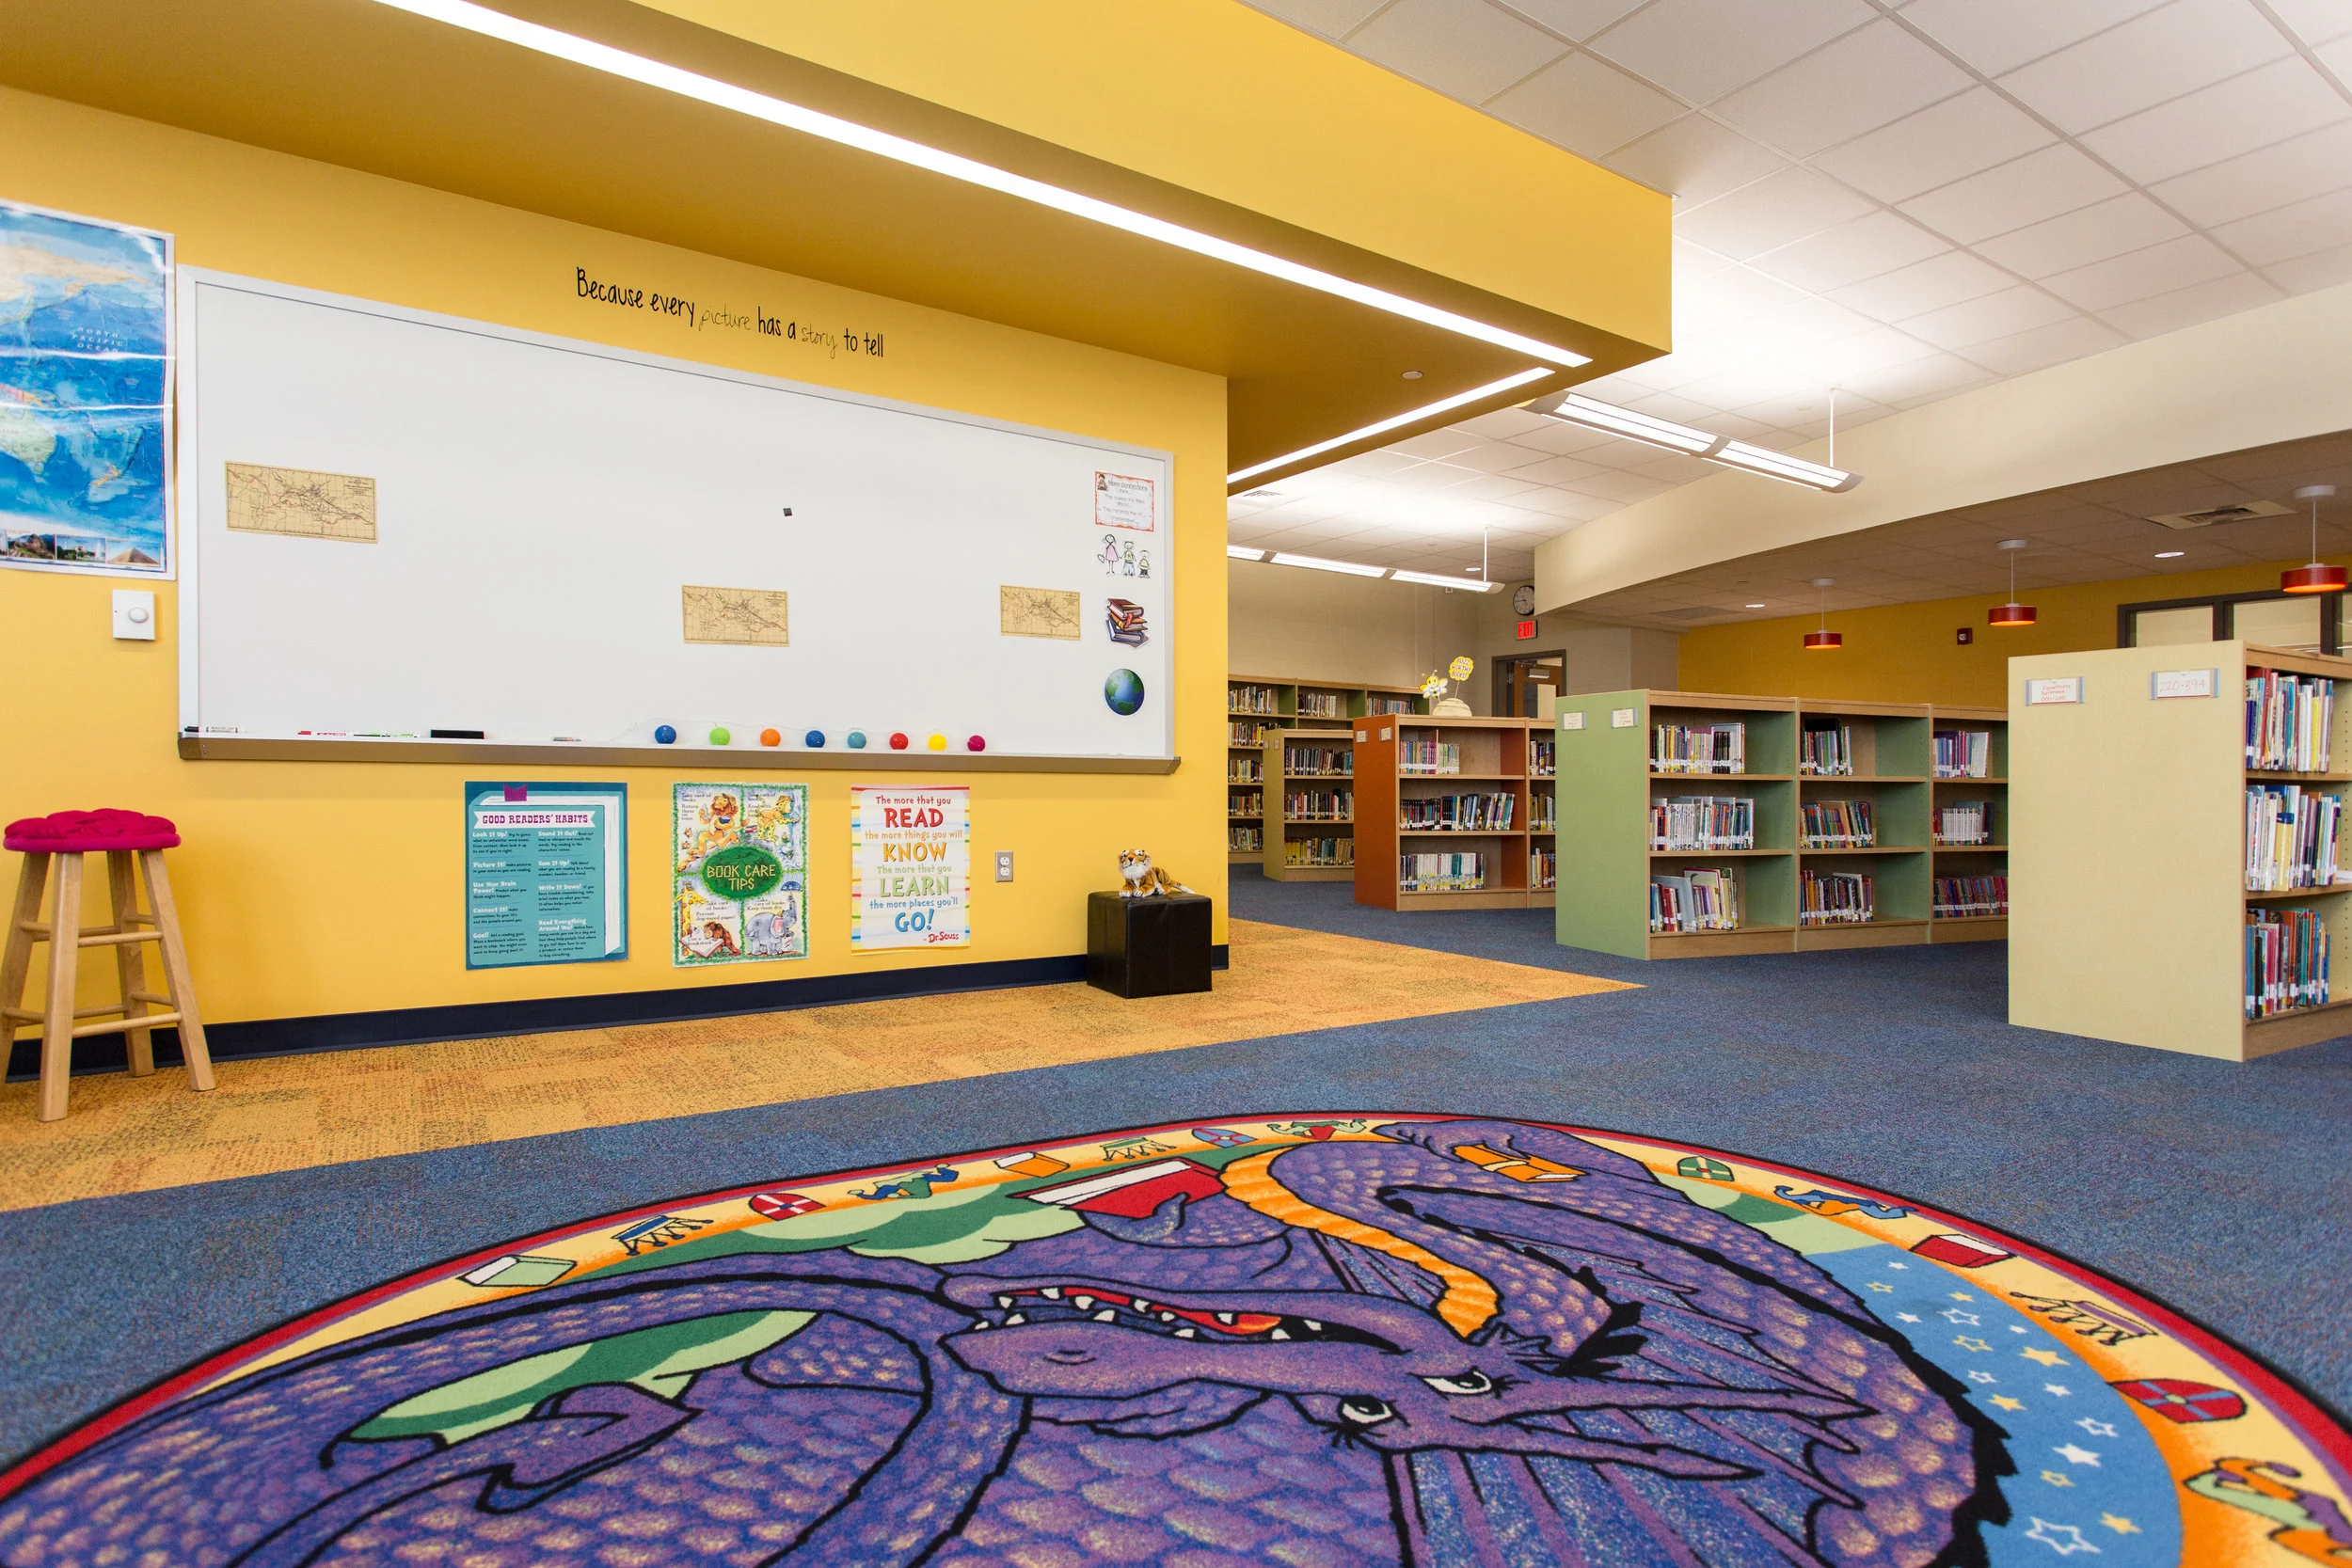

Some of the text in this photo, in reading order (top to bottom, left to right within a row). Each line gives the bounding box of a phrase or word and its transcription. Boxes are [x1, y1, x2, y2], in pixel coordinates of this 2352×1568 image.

[577, 266, 883, 359] Because every picture has a story to tell
[1518, 621, 1534, 639] EXIT
[876, 795, 891, 804] The
[916, 795, 934, 804] that
[936, 798, 951, 806] you
[483, 815, 505, 824] GOOD
[555, 815, 588, 823] HABITS
[884, 808, 944, 828] READ
[865, 830, 879, 839] the
[904, 830, 930, 841] things
[932, 832, 946, 840] you
[949, 829, 962, 838] will
[882, 841, 946, 862] KNOW
[707, 864, 776, 878] BOOK CARE
[877, 864, 892, 874] The
[917, 863, 935, 873] that
[937, 865, 952, 874] you
[728, 877, 755, 891] TIPS
[881, 876, 949, 897] LEARN
[869, 896, 958, 910] the more places you'll
[895, 908, 934, 933] GO!
[939, 931, 959, 941] Seuss
